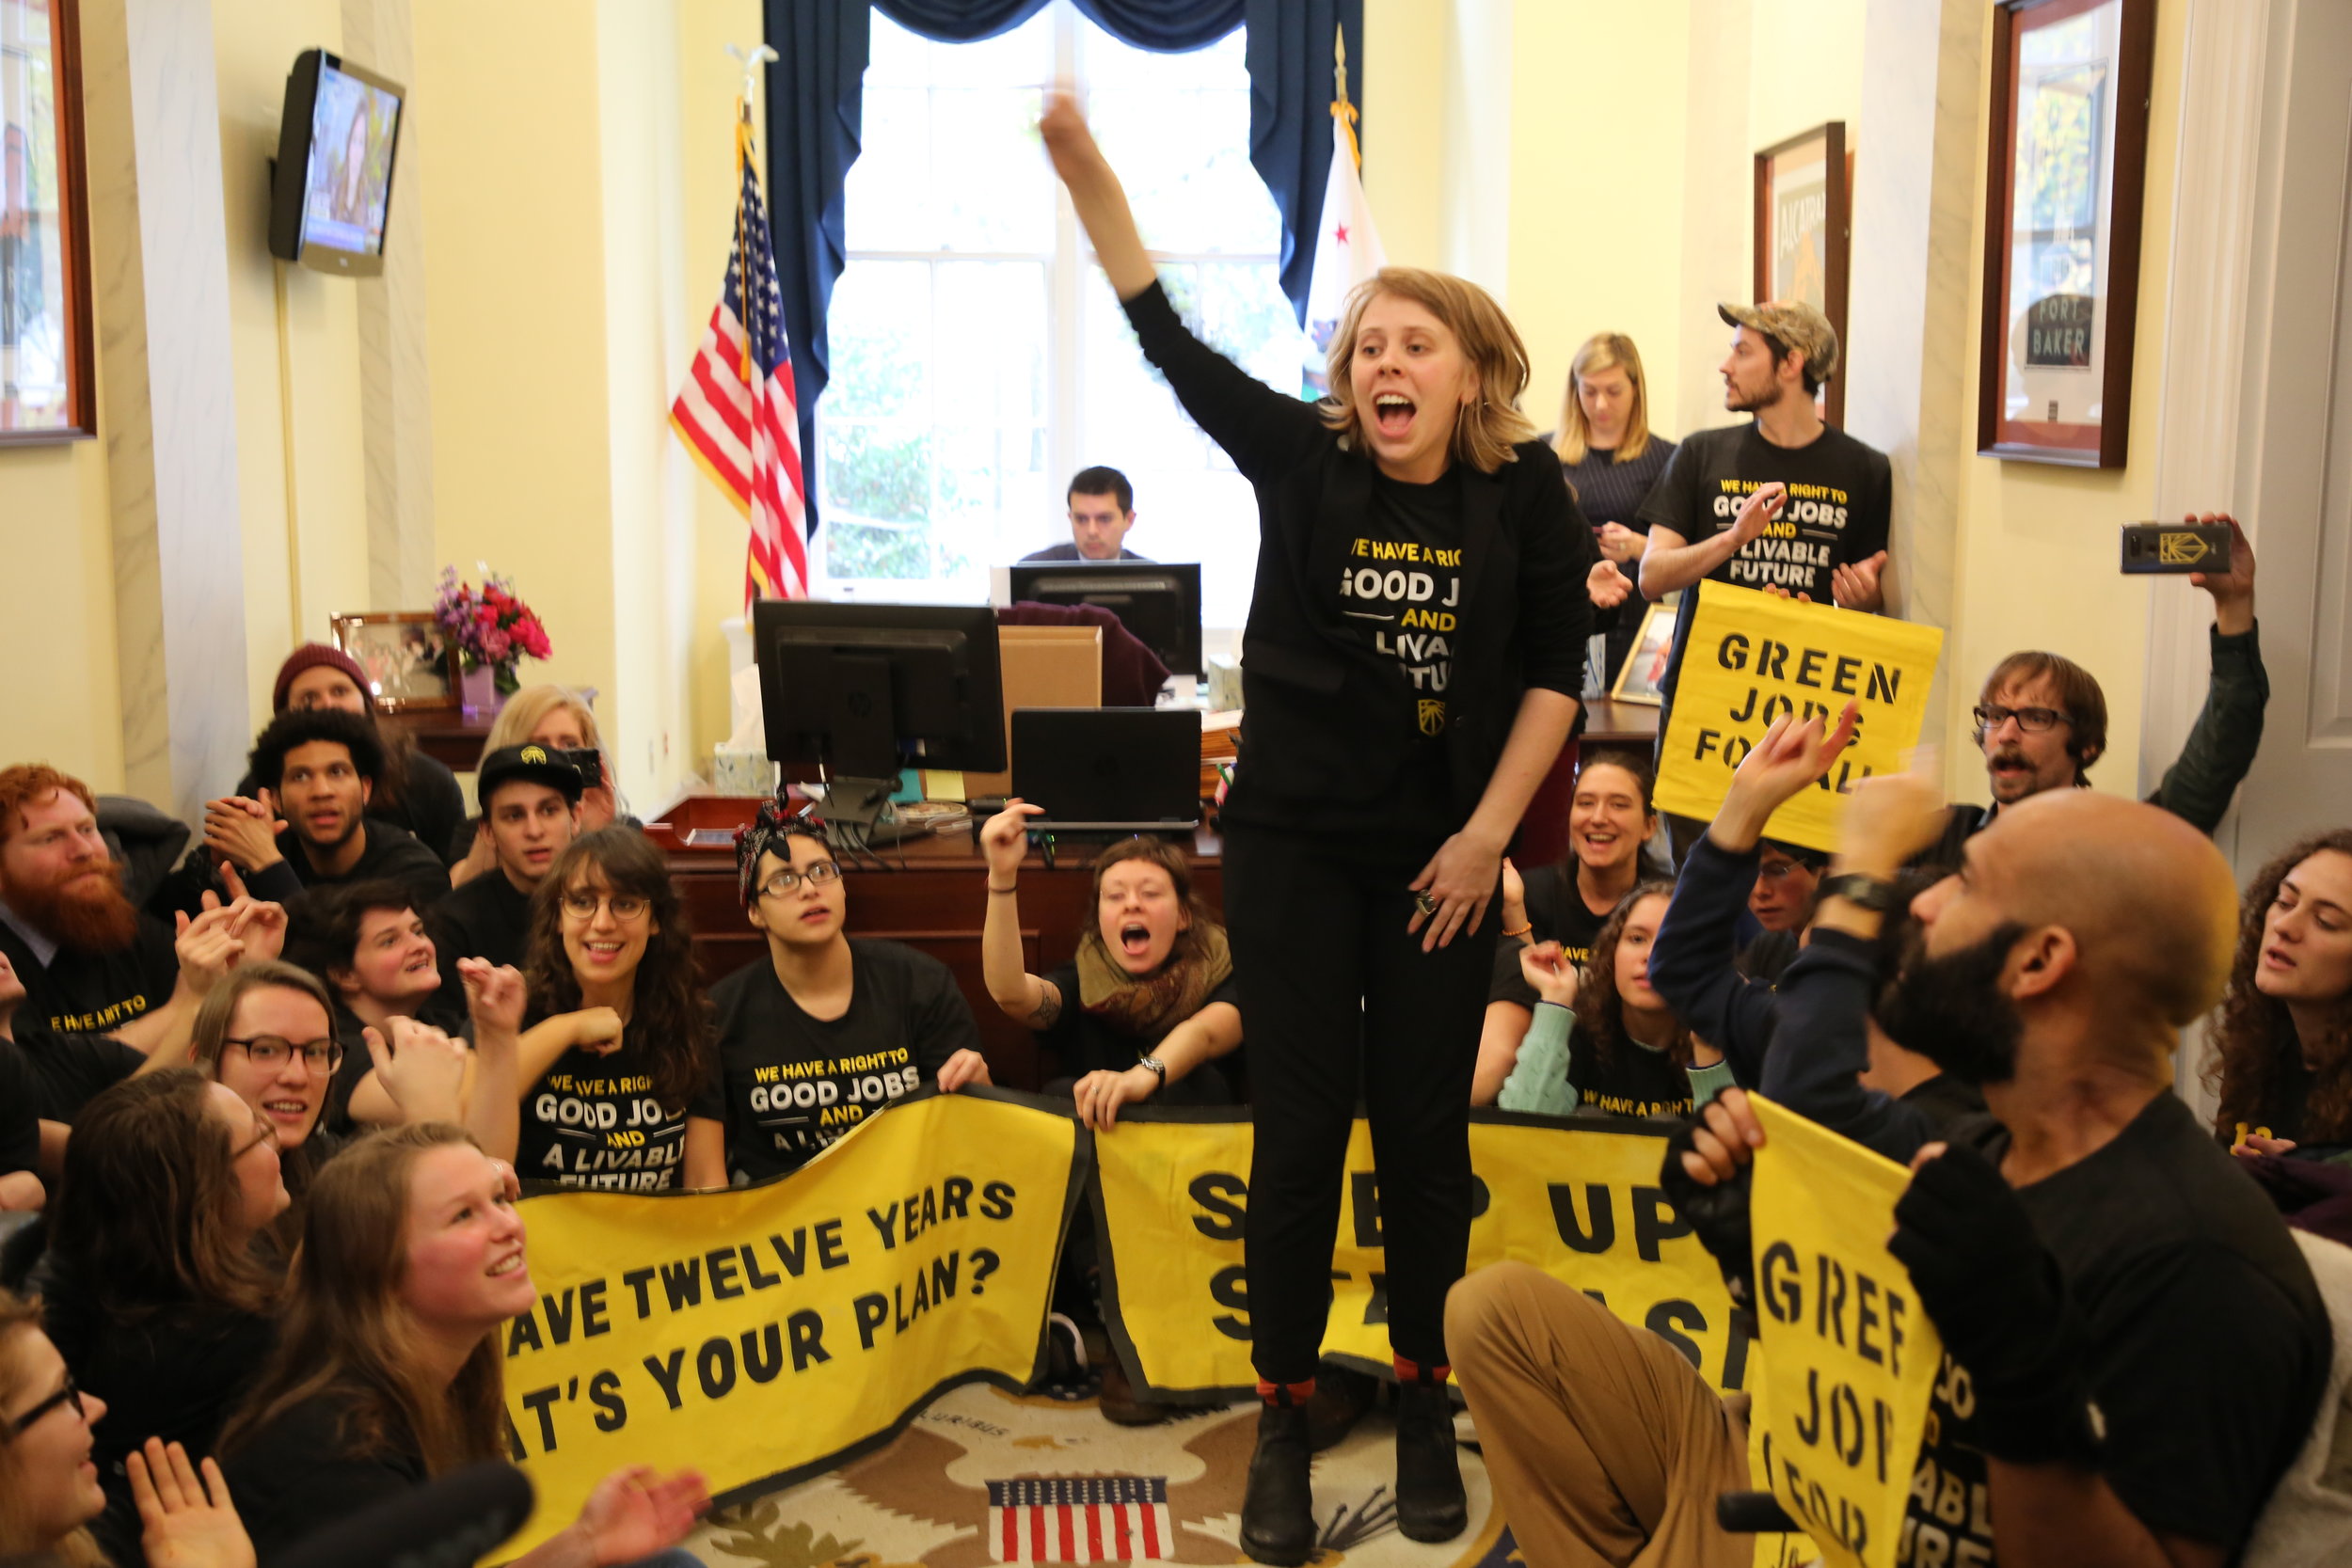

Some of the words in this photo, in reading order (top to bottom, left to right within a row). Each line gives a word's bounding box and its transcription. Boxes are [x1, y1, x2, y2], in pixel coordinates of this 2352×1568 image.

[1779, 191, 1825, 260] ALCATRA
[2040, 298, 2080, 323] FORT
[2033, 328, 2085, 356] BAKER
[1721, 480, 1740, 493] WE
[1789, 483, 1829, 499] RIGHT
[1831, 487, 1848, 504] TO
[1788, 500, 1848, 529] JOBS
[1762, 522, 1797, 539] AND
[1351, 538, 1370, 557] E
[1372, 541, 1420, 562] HAVE
[1422, 546, 1435, 564] A
[1740, 539, 1831, 567] LIVABLE
[1729, 560, 1816, 588] FUTURE
[1401, 608, 1457, 631] AND
[1376, 631, 1454, 662] LIVA
[1717, 632, 1901, 705] GREEN
[1694, 728, 1751, 769] FO
[1562, 945, 1589, 962] AVE
[121, 994, 146, 1015] TO
[755, 1066, 780, 1084] WE
[783, 1059, 824, 1080] HAVE
[827, 1059, 837, 1075] A
[839, 1052, 887, 1074] RIGHT
[887, 1047, 909, 1067] TO
[548, 1075, 573, 1092] WE
[751, 1080, 838, 1114] GOOD
[847, 1066, 921, 1104] JOBS
[535, 1093, 617, 1129] GOOD
[820, 1104, 864, 1127] AND
[1636, 1101, 1648, 1117] A
[607, 1131, 645, 1148] AND
[774, 1132, 792, 1152] A
[542, 1143, 564, 1171] A
[1547, 1182, 1694, 1262] UP
[507, 1277, 611, 1357] AVE
[623, 1217, 850, 1321] TWELVE
[866, 1176, 1016, 1250] YEARS
[504, 1369, 628, 1462] T'S
[642, 1307, 833, 1411] YOUR
[853, 1247, 1000, 1351] PLAN?
